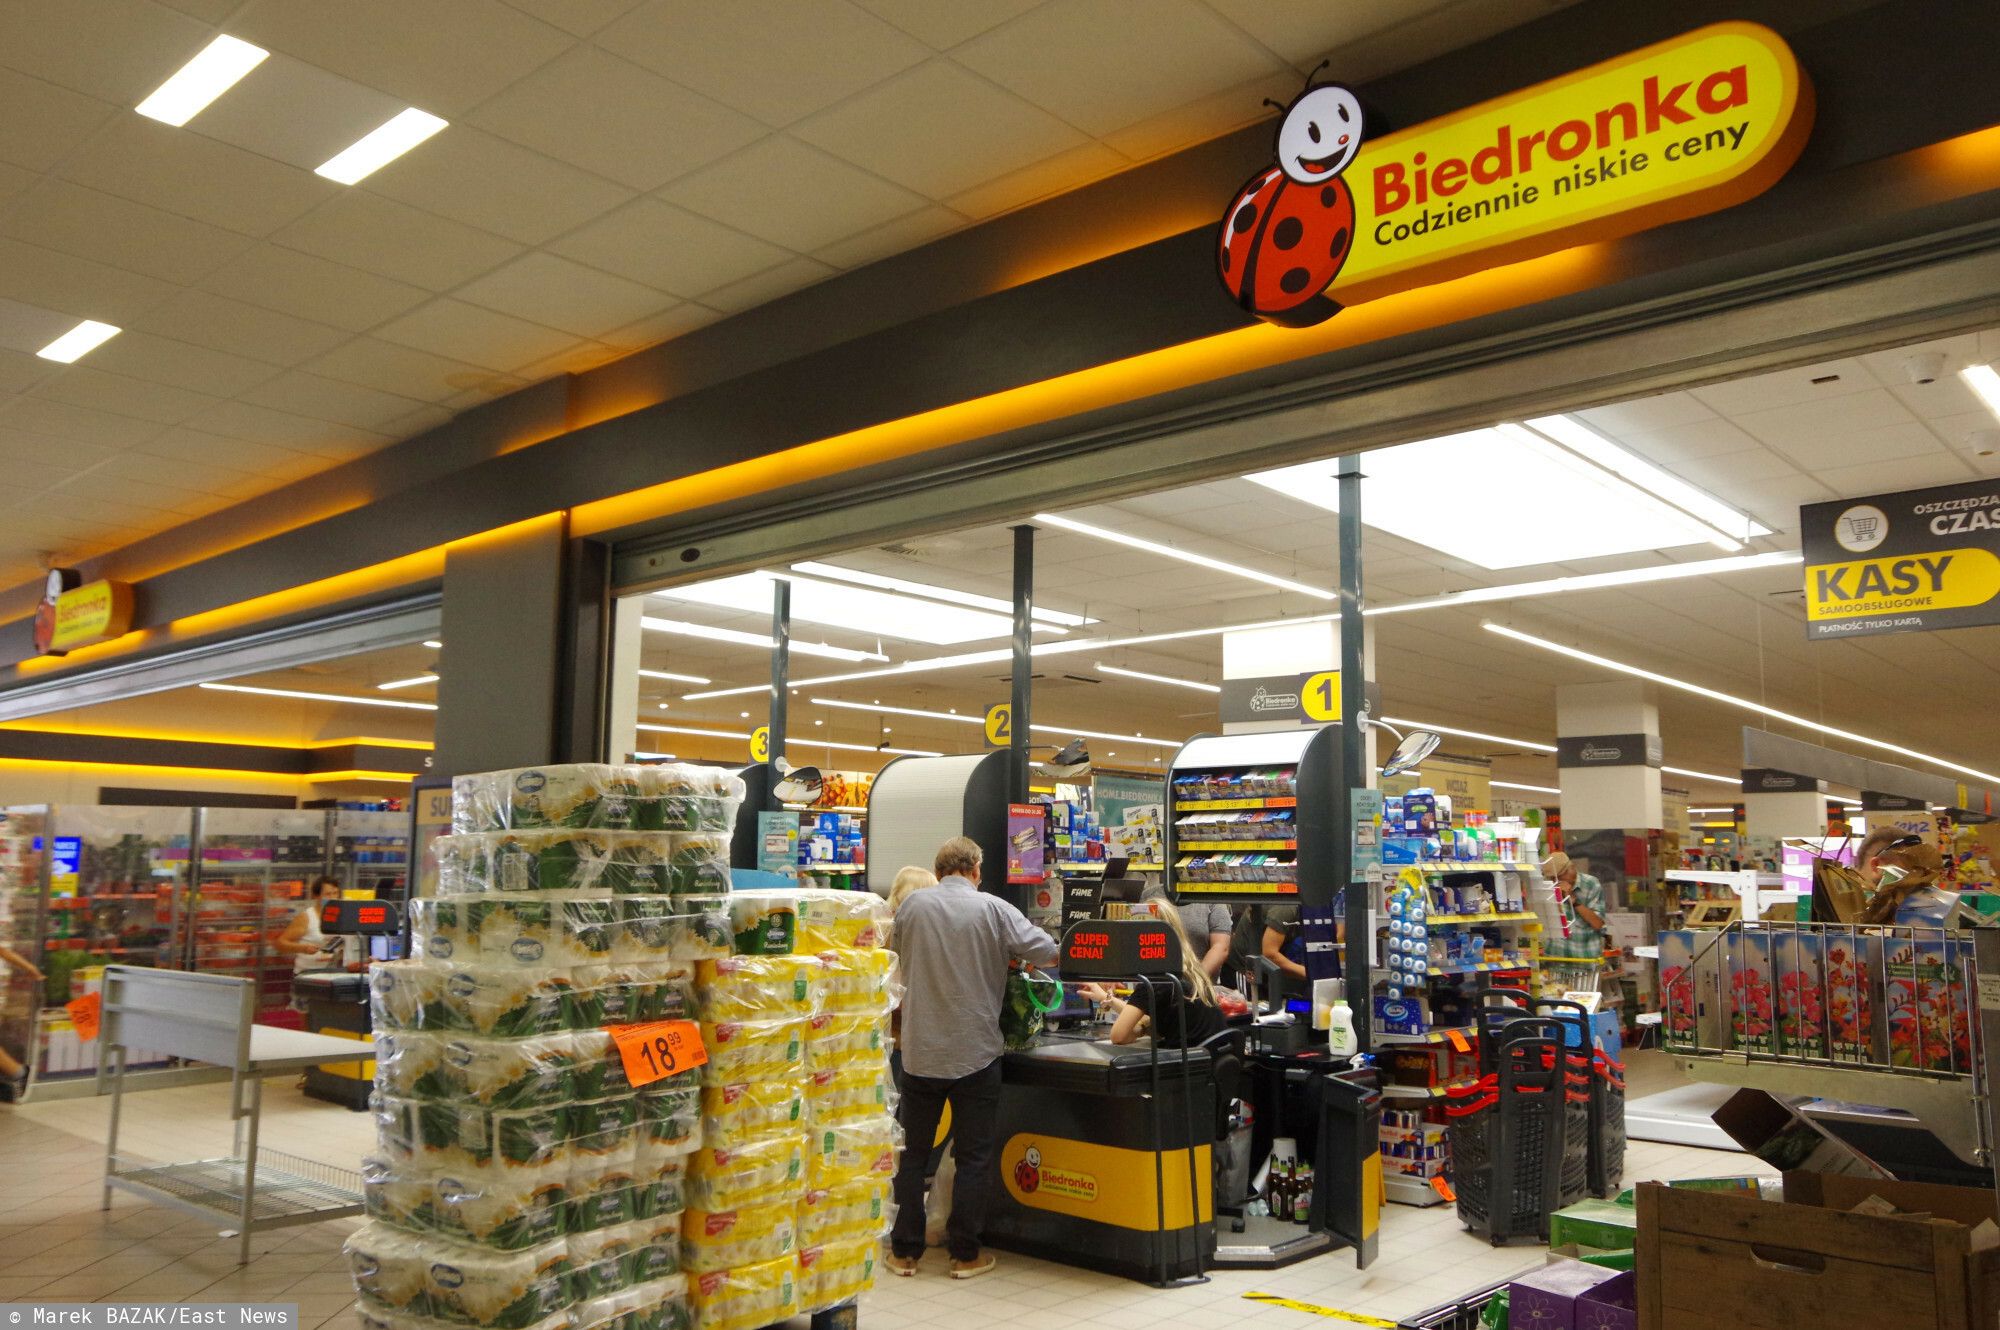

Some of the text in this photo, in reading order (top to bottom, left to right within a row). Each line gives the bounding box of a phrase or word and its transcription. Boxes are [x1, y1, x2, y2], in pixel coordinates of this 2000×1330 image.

[1372, 64, 1749, 217] Biedronka
[1374, 120, 1750, 246] Codziennie niskie ceny
[1816, 555, 1954, 603] KASY
[1818, 596, 1933, 615] SAMOOBSŁUGOWE
[1865, 619, 1892, 630] TYLKO
[1317, 678, 1332, 711] 1
[995, 710, 1010, 738] 2
[758, 732, 769, 755] 3
[1069, 911, 1091, 919] FAME
[1075, 933, 1109, 946] SUPER
[1139, 934, 1166, 946] SUPER
[1070, 947, 1104, 959] CENA!
[1140, 948, 1166, 959] CENA!
[1042, 1171, 1094, 1190] Biedronka
